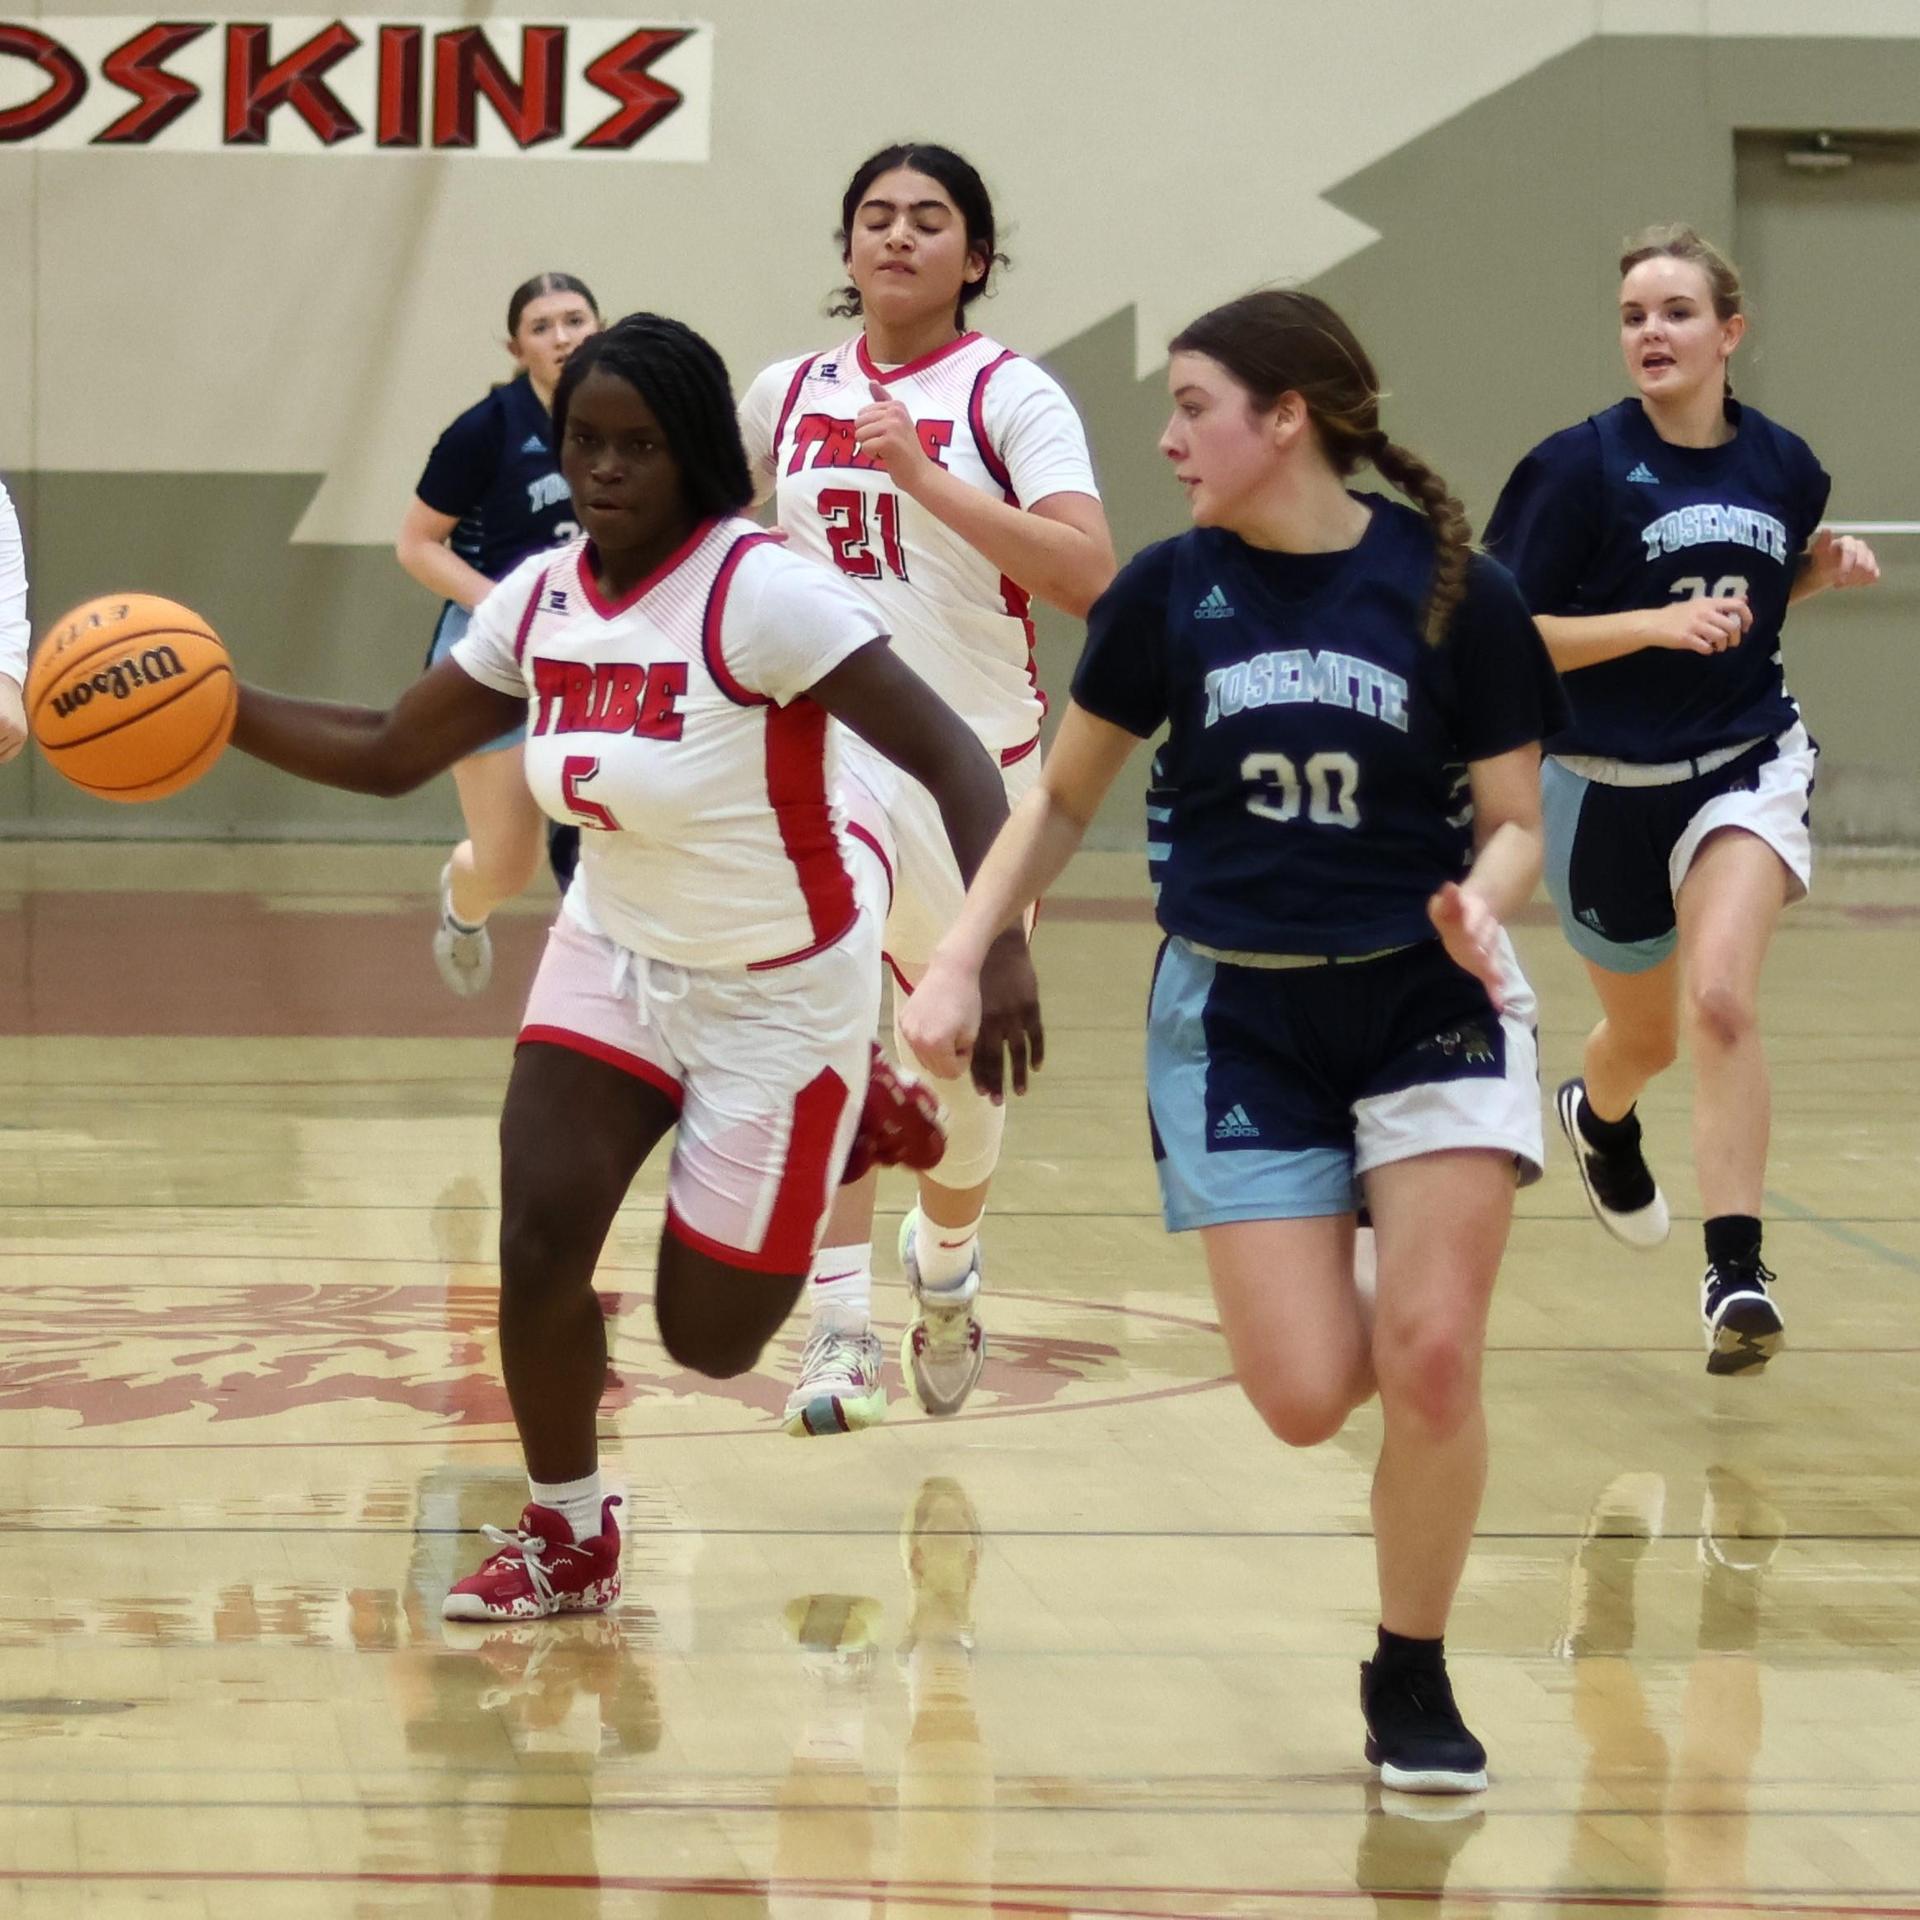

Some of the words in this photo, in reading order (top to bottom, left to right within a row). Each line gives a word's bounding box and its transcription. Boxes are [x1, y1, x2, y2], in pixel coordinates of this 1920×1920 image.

[787, 414, 954, 476] TRE
[817, 488, 909, 581] 21
[1641, 503, 1787, 565] YOSEMITE
[51, 645, 186, 718] Wilson
[532, 656, 688, 741] TRIBE
[1204, 648, 1408, 733] YOSEMITE
[562, 755, 623, 831] 5
[1240, 751, 1361, 829] 30
[1214, 1127, 1260, 1139] adidas
